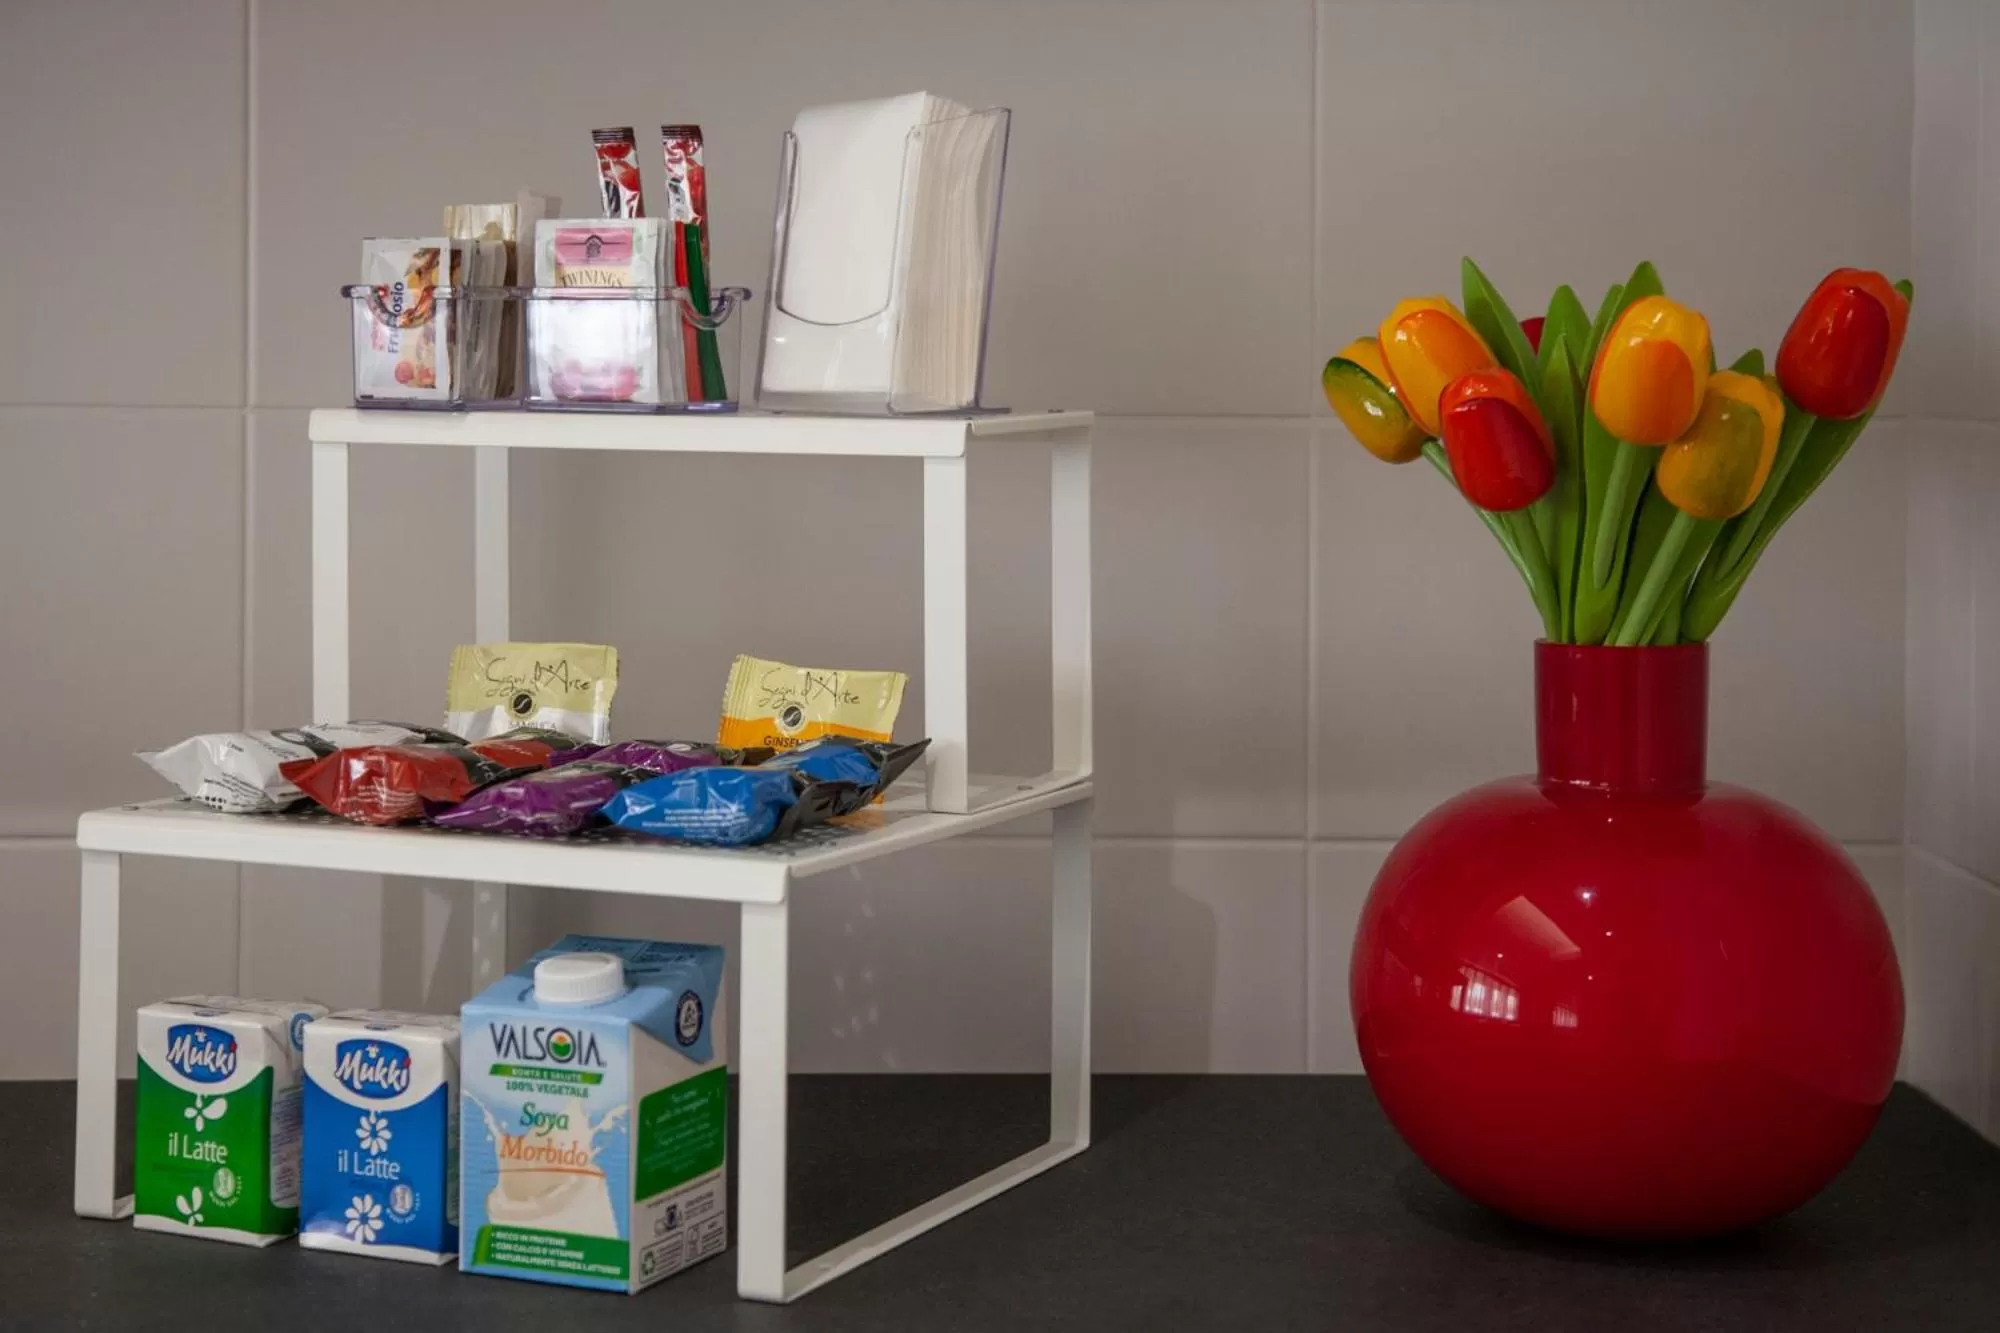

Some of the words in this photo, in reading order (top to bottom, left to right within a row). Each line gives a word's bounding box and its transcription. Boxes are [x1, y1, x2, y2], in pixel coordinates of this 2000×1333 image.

[560, 268, 623, 288] TWININGS
[166, 1034, 237, 1075] Mukki
[489, 1022, 602, 1067] VALSOIA
[334, 1050, 411, 1090] Mukki
[506, 1080, 534, 1093] 100%
[536, 1083, 589, 1098] VEGETALE
[520, 1102, 569, 1137] Soya
[168, 1132, 179, 1156] il
[183, 1134, 228, 1164] Latte
[500, 1135, 588, 1166] Morbido
[337, 1150, 348, 1173] il
[354, 1151, 401, 1180] Latte
